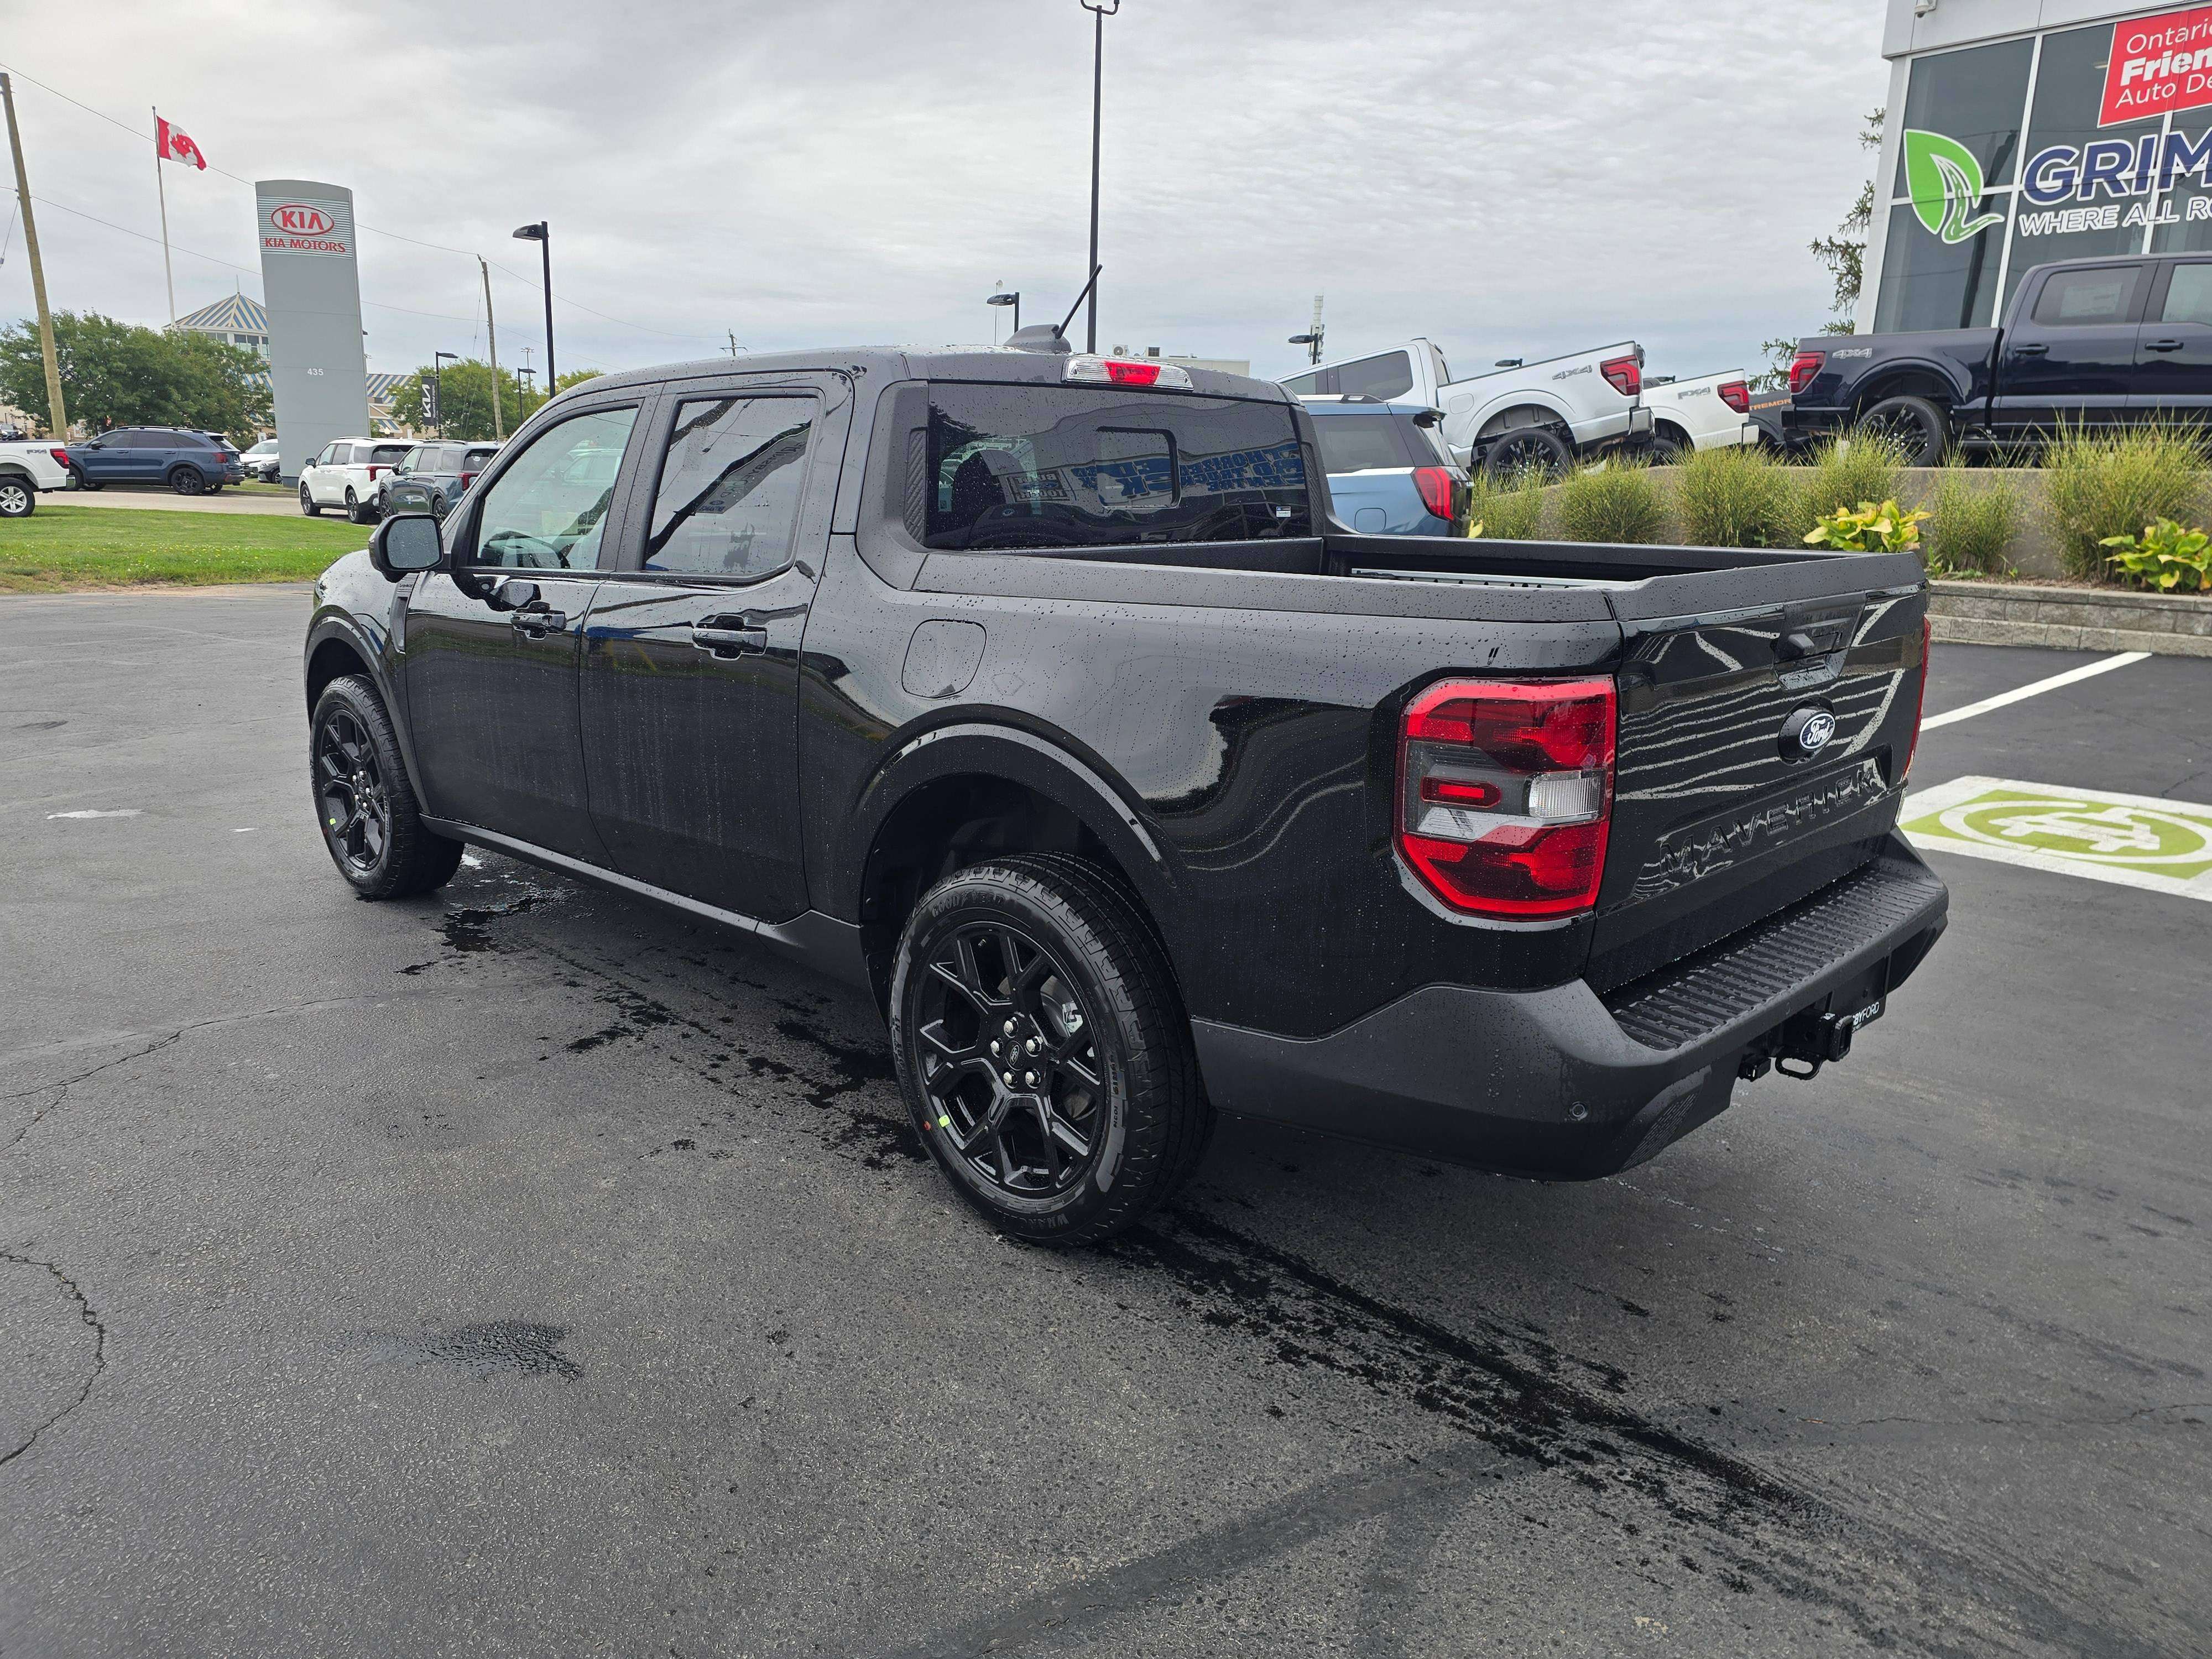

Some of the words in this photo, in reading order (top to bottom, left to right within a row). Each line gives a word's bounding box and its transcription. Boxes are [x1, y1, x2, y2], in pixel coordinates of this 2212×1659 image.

[2126, 18, 2212, 54] Ontari
[2120, 46, 2212, 86] Frien
[2115, 83, 2176, 108] Auto
[2022, 128, 2212, 205] GRIM
[281, 210, 324, 230] KIA
[2019, 205, 2120, 237] WHERE
[2122, 200, 2180, 227] ALL
[265, 237, 285, 248] KIA
[290, 238, 346, 253] MOTORS
[307, 368, 324, 376] 435
[1806, 717, 1832, 745] Ford
[1853, 1001, 1880, 1026] BYFORD
